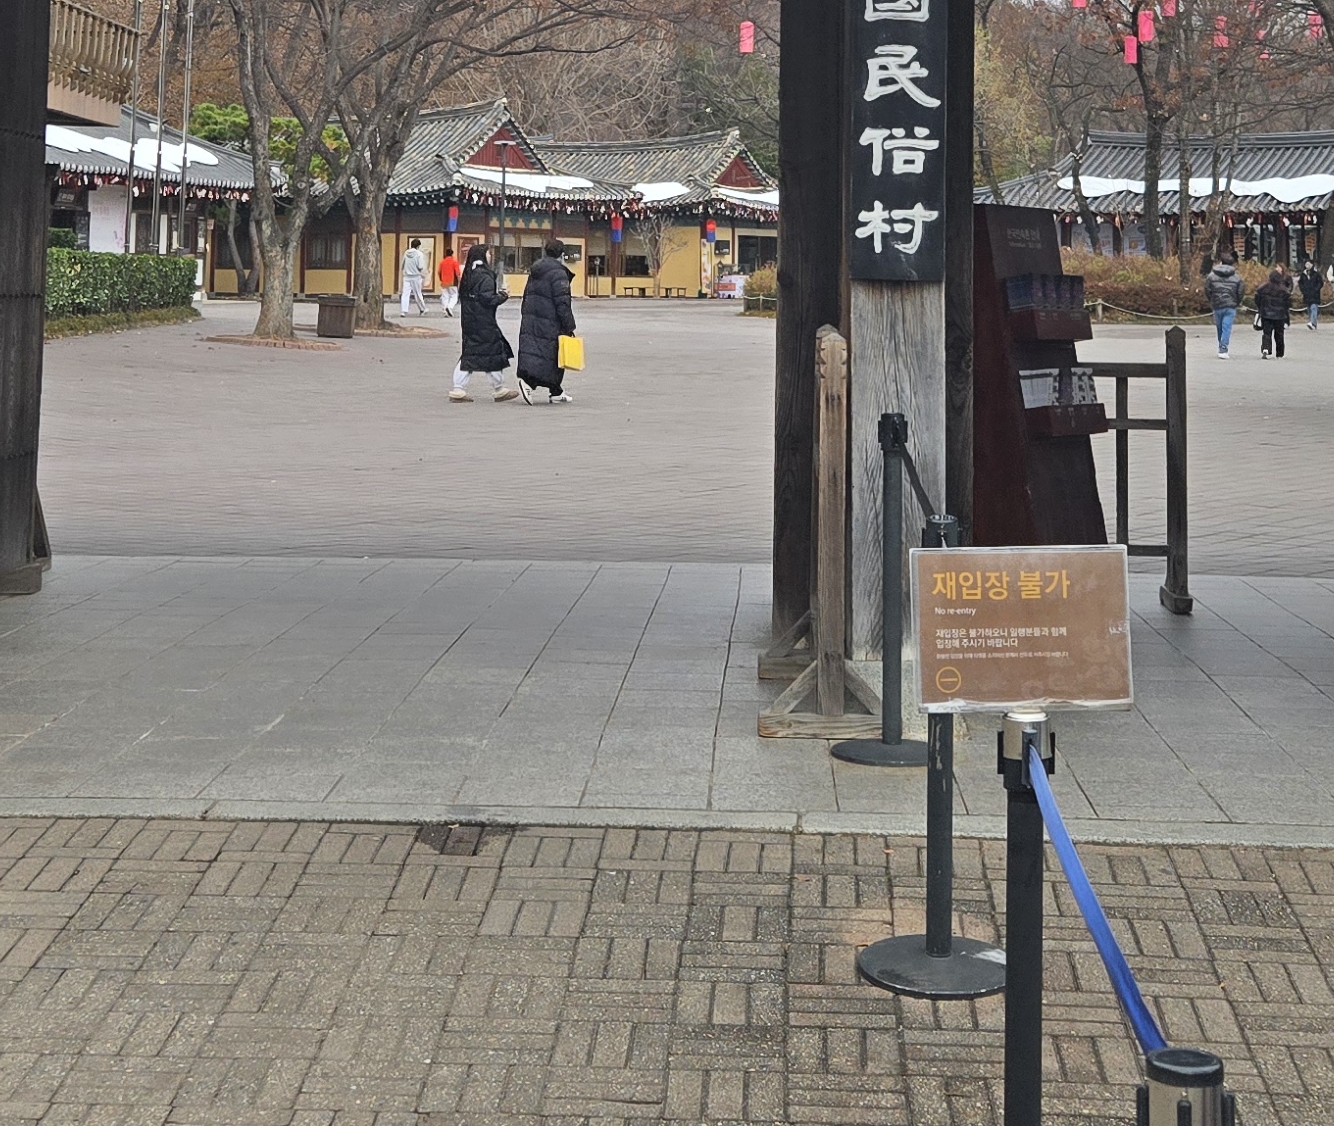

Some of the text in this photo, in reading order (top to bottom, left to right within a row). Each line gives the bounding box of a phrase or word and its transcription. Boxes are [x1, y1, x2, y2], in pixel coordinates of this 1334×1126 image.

[931, 569, 1071, 601] 재입장 불가
[934, 606, 977, 617] No re-entry
[935, 628, 967, 638] 재입장은
[968, 628, 1008, 638] 불가하오니
[961, 638, 985, 649] 주시기
[987, 638, 1019, 648] 바랍니다
